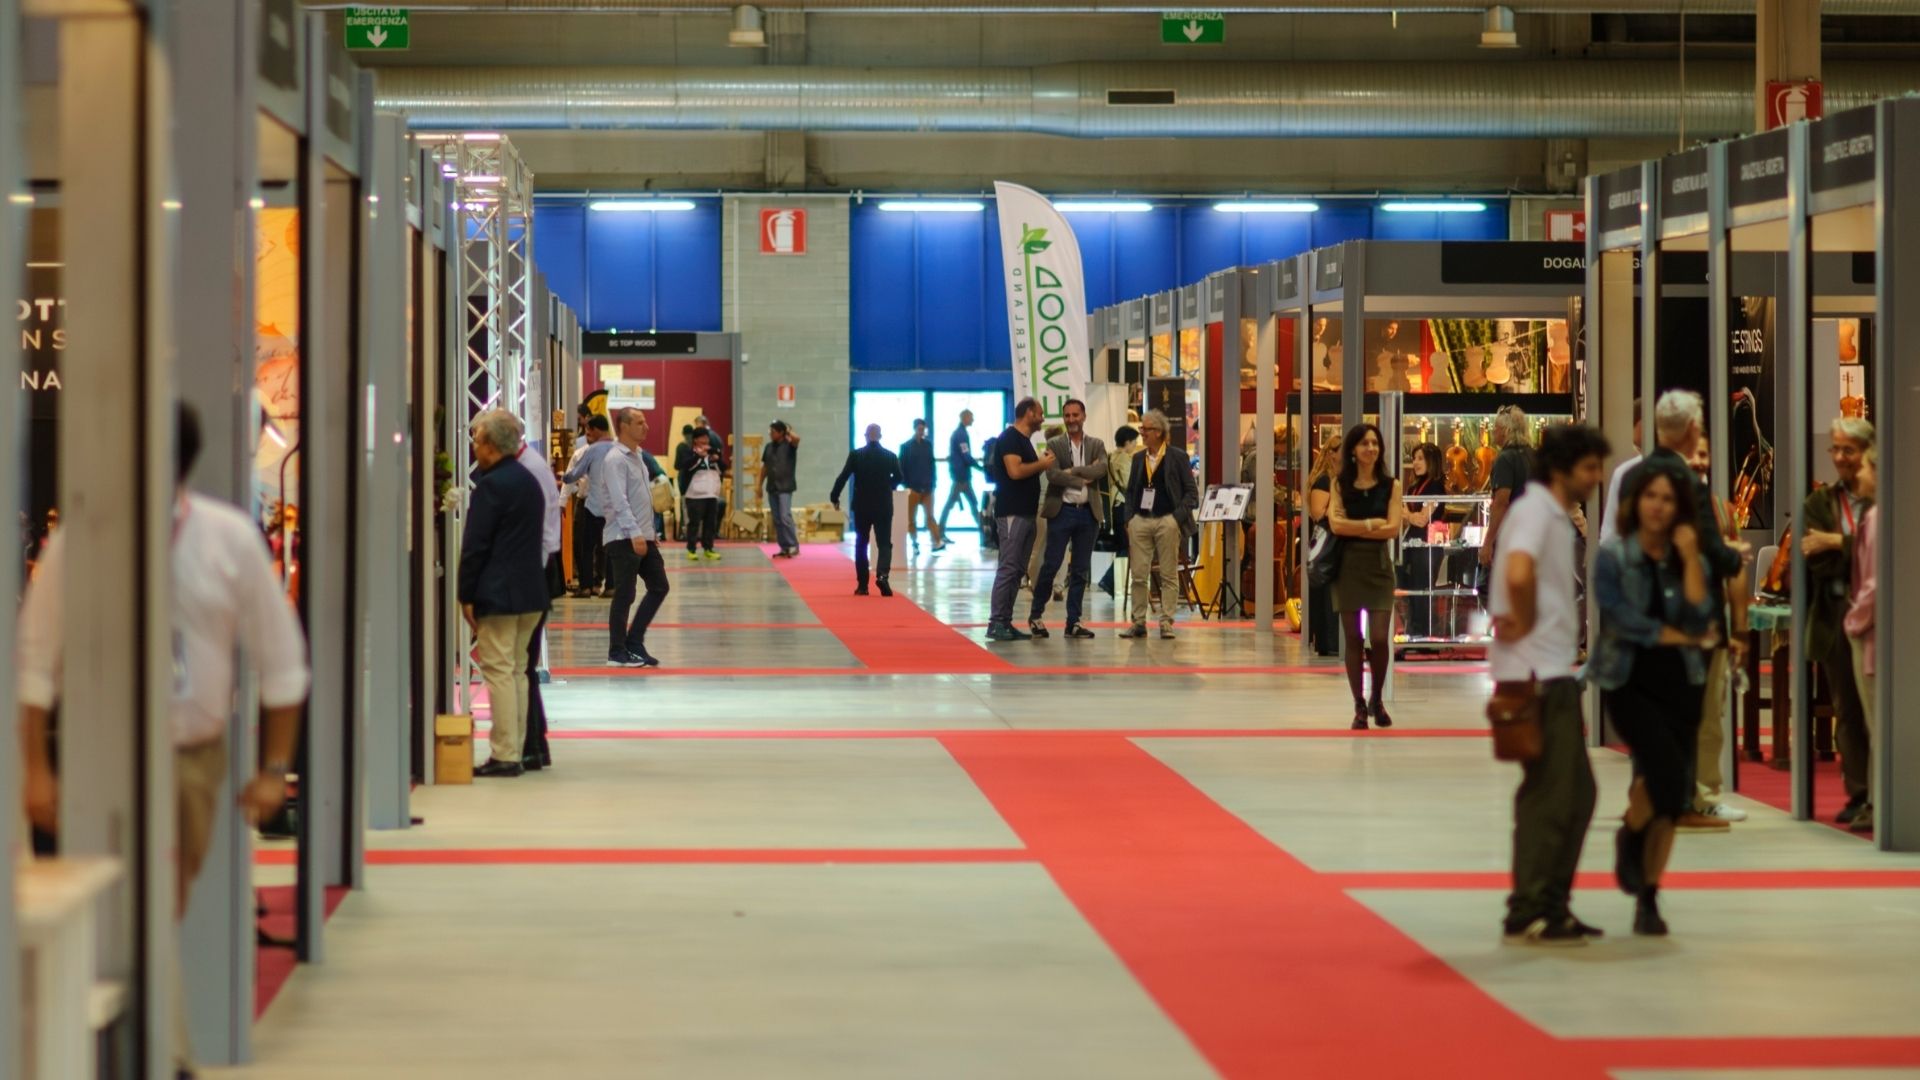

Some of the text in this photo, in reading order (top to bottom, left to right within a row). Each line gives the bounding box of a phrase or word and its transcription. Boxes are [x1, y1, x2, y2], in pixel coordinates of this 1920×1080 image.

[353, 8, 400, 16] USCITA DI
[1163, 12, 1224, 20] EMERGENZA
[346, 16, 407, 26] EMERGENZA
[620, 339, 634, 347] TOP
[634, 339, 656, 347] WOOD
